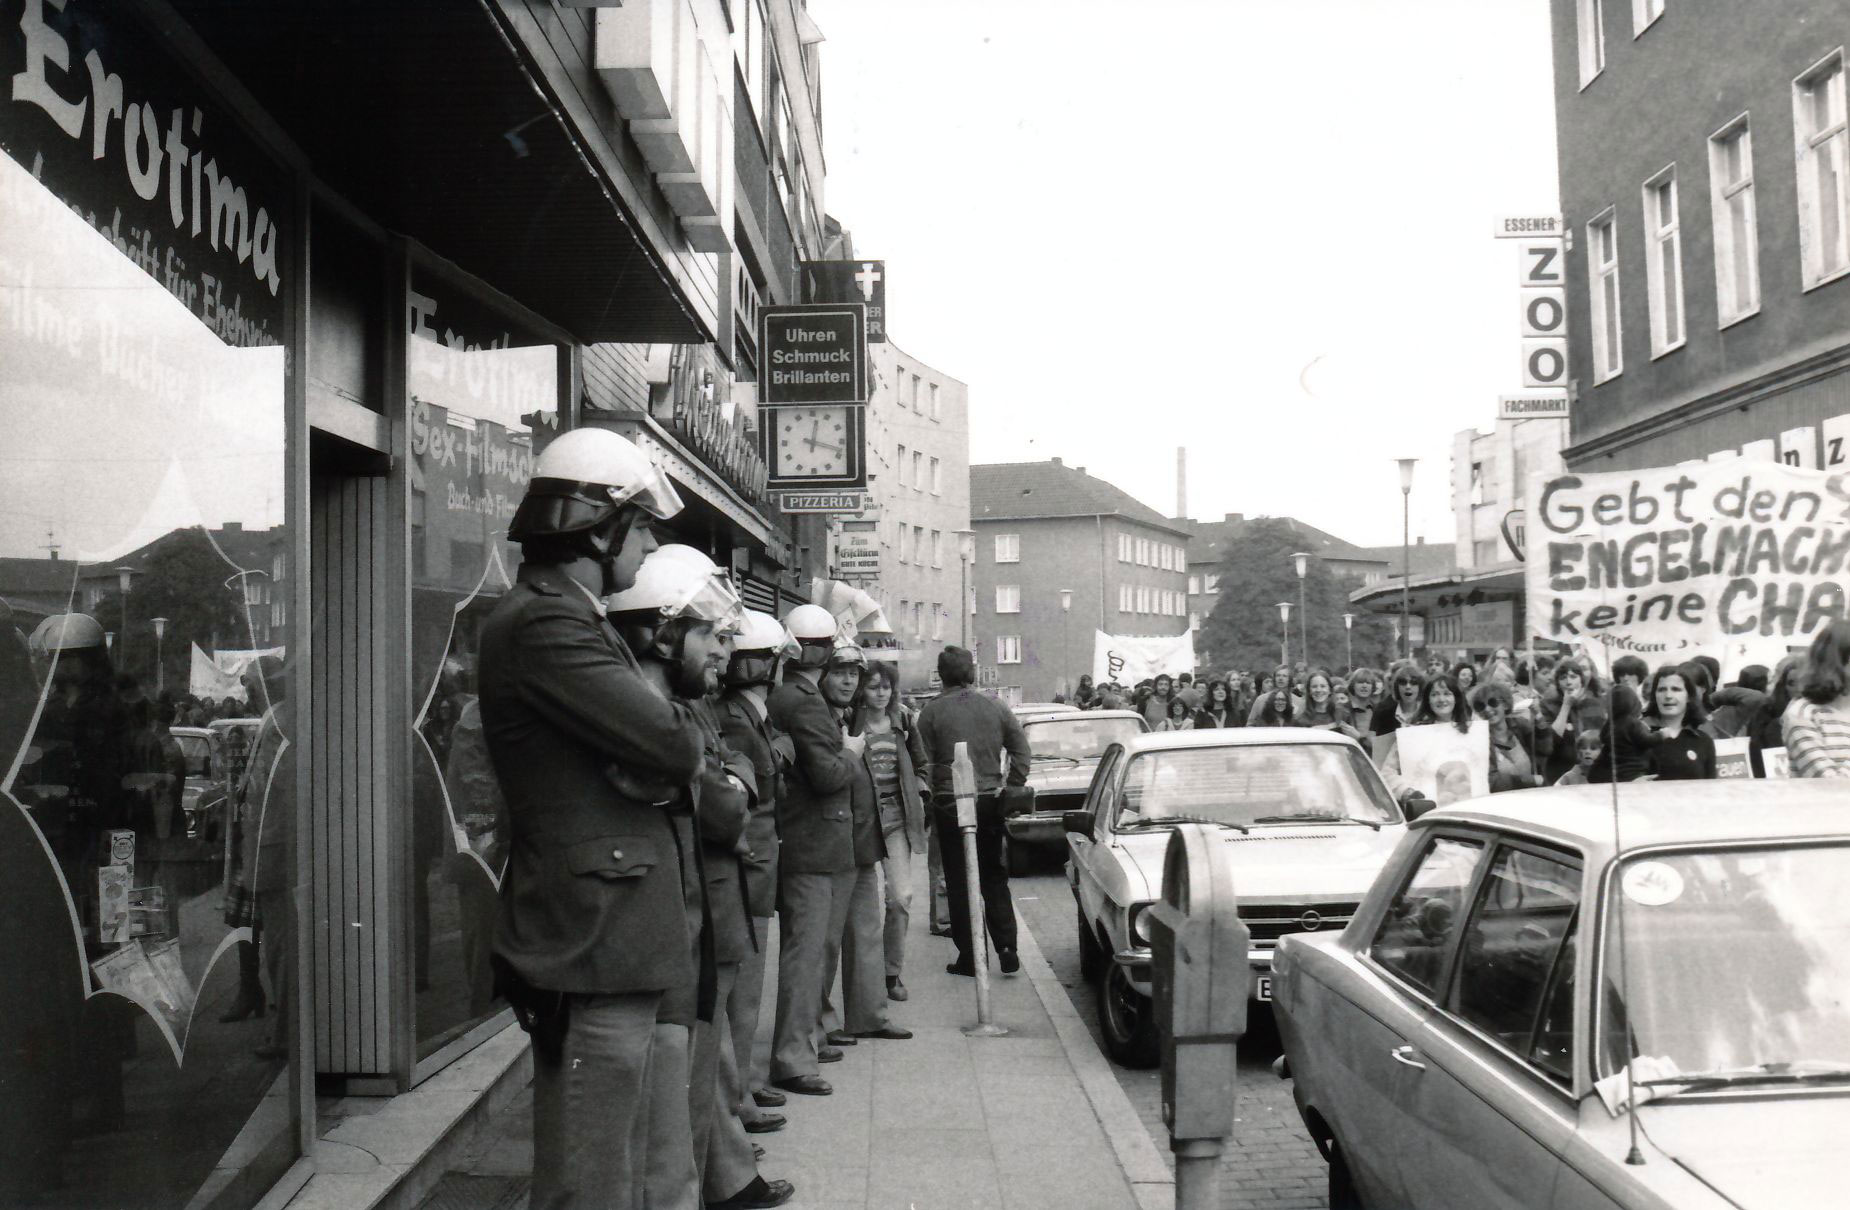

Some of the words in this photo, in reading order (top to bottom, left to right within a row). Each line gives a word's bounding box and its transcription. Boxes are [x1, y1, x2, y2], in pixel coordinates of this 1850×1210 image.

[12, 0, 280, 297] Erotima
[1504, 217, 1556, 232] ESSENER
[1526, 248, 1565, 382] ZOO
[785, 328, 836, 342] Uhren
[772, 348, 851, 364] Schmuck
[772, 370, 850, 384] Brillanten
[1504, 399, 1567, 413] FACHMARKT
[790, 497, 854, 508] PIZZERIA
[1540, 476, 1698, 534] Gebt
[1713, 476, 1822, 523] den
[1548, 523, 1850, 592] ENGELMACH
[1551, 592, 1706, 636] keine
[1592, 633, 1667, 652] entrum
